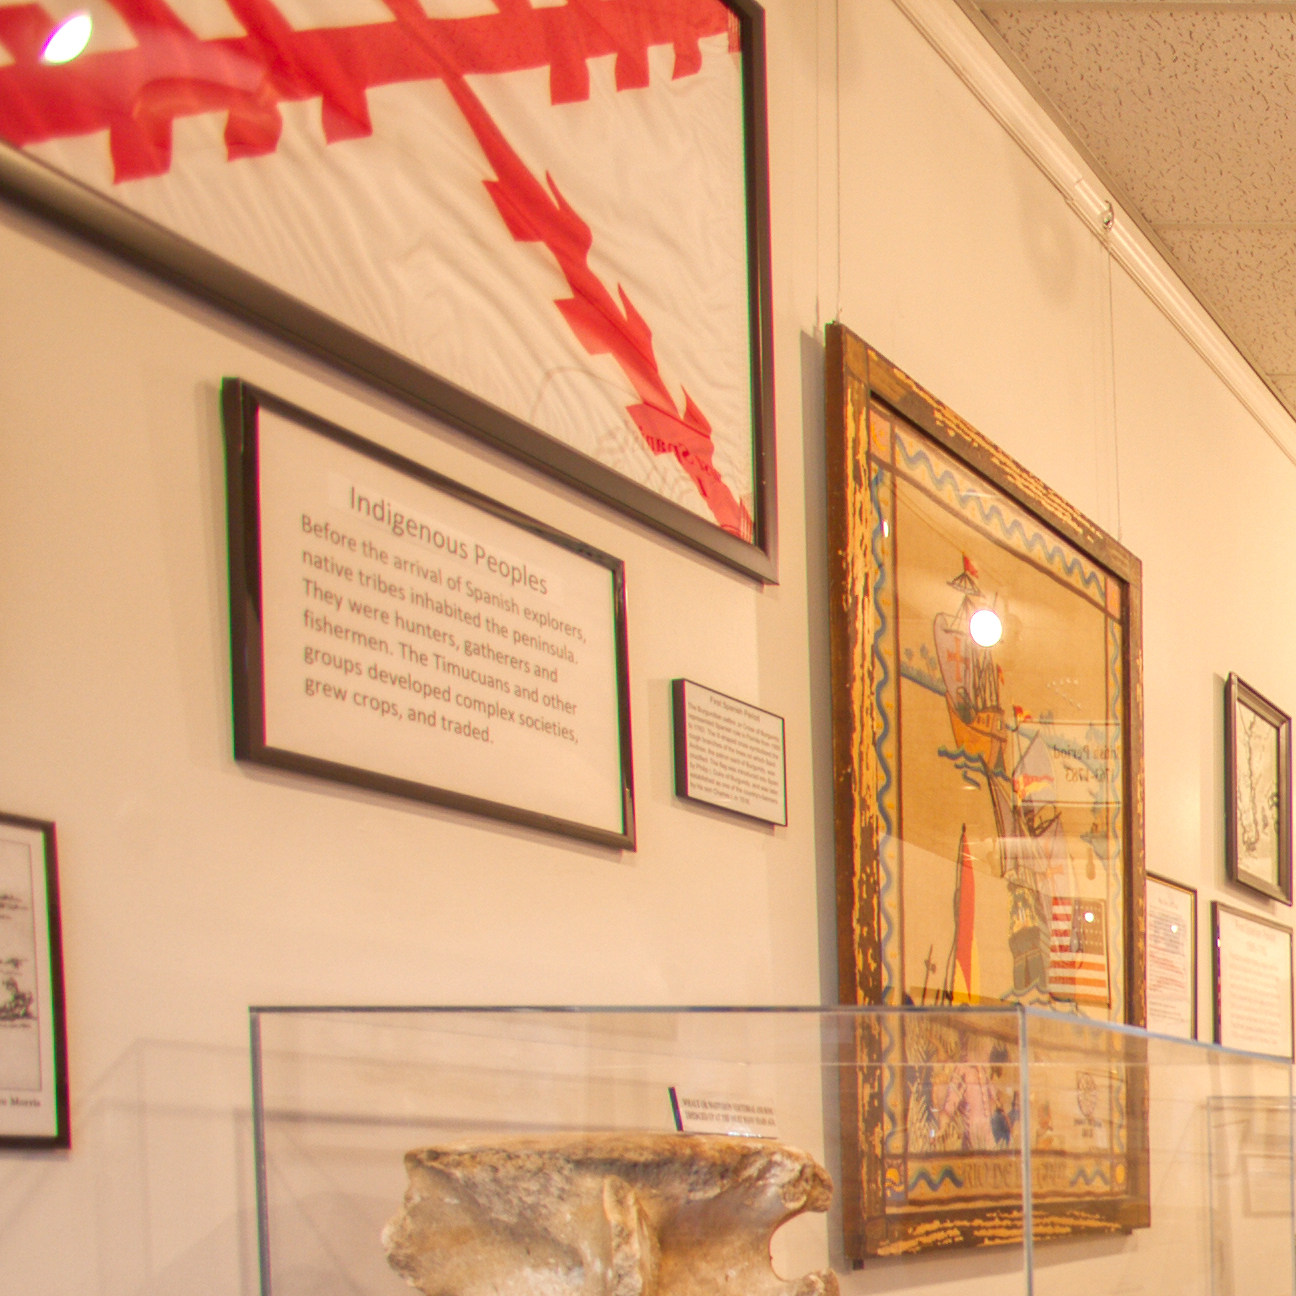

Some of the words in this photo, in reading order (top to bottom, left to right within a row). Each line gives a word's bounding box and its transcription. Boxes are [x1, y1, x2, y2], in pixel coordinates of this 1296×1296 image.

[301, 513, 356, 551] Before
[361, 540, 388, 564] the
[393, 556, 441, 584] arrival
[446, 576, 461, 592] of
[465, 580, 519, 615] Spanish
[523, 607, 586, 643] explorers,
[350, 486, 469, 561] Indigenous
[474, 544, 549, 597] Peoples
[302, 551, 352, 581] native
[358, 569, 405, 600] tribes
[410, 591, 480, 628] inhabited
[485, 617, 508, 638] the
[512, 630, 578, 664] peninsula.
[302, 577, 342, 610] They
[348, 598, 389, 624] were
[395, 610, 459, 650] hunters,
[463, 639, 530, 673] gatherers
[533, 664, 557, 682] and
[303, 608, 392, 655] fishermen.
[398, 641, 428, 666] The
[433, 653, 510, 693] Timucuans
[514, 684, 538, 702] and
[542, 694, 577, 715] other
[304, 646, 362, 675] groups
[367, 663, 450, 702] developed
[455, 693, 514, 722] complex
[519, 713, 578, 744] societies,
[304, 678, 347, 701] grew
[353, 692, 402, 720] crops,
[407, 708, 436, 726] and
[441, 715, 493, 743] traded.
